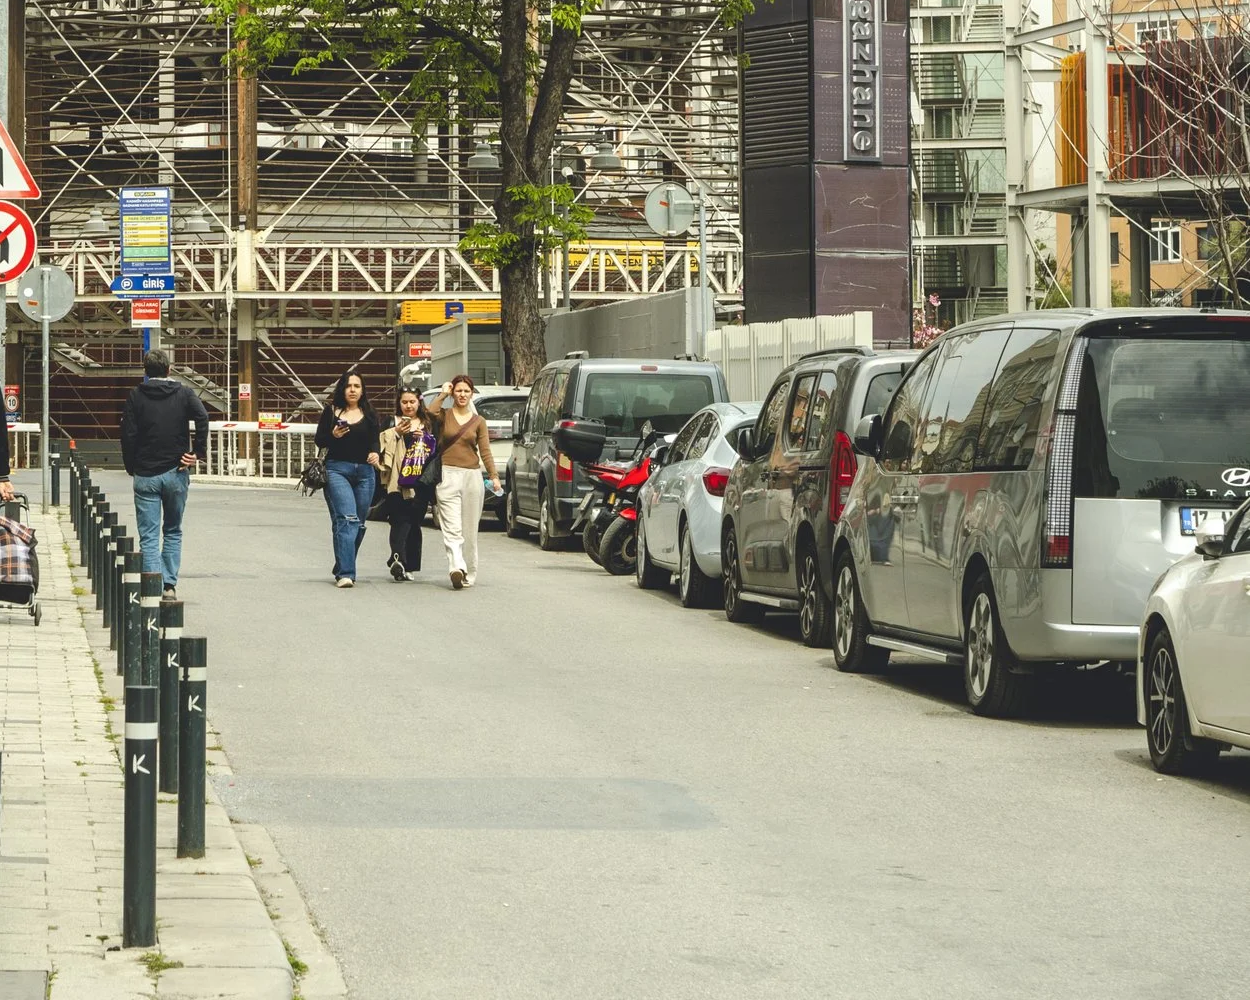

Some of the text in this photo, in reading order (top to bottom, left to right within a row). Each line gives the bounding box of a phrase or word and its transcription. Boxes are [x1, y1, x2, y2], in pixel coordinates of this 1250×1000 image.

[849, 0, 879, 151] gazhane
[142, 278, 165, 290] GİRİŞ
[445, 302, 464, 319] P
[8, 398, 17, 407] 10
[129, 591, 140, 604] K
[147, 617, 158, 631] K
[167, 652, 180, 668] K
[188, 694, 202, 712] K
[132, 754, 150, 775] K
